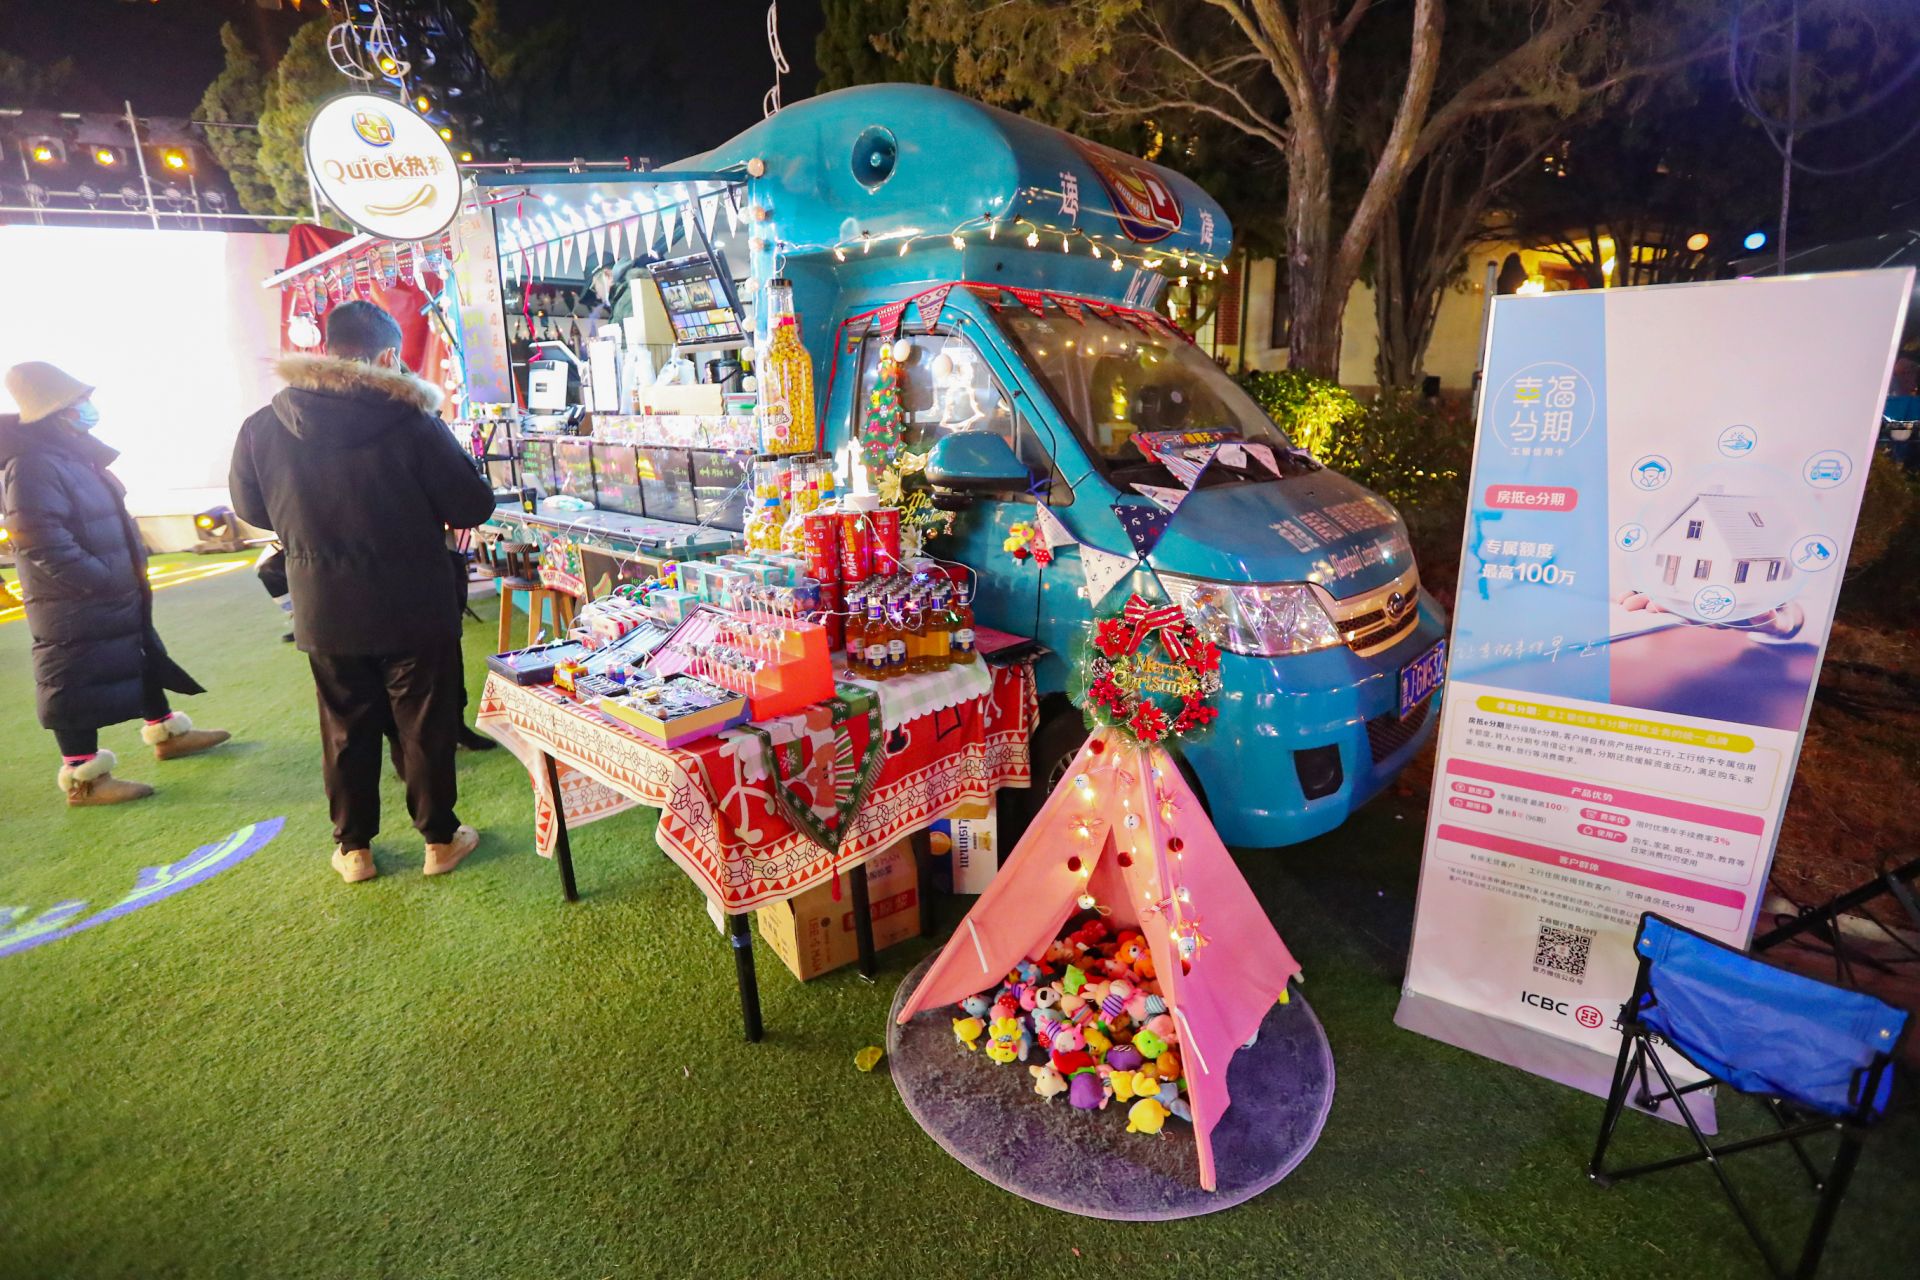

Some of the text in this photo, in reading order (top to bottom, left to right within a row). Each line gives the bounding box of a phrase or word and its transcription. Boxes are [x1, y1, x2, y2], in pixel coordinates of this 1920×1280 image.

[1496, 490, 1566, 506] 房抵e分期
[1487, 539, 1555, 559] 专属额度
[1482, 562, 1577, 586] 最高100万
[1570, 786, 1613, 803] 产品优势
[1521, 990, 1569, 1016] ICBC
